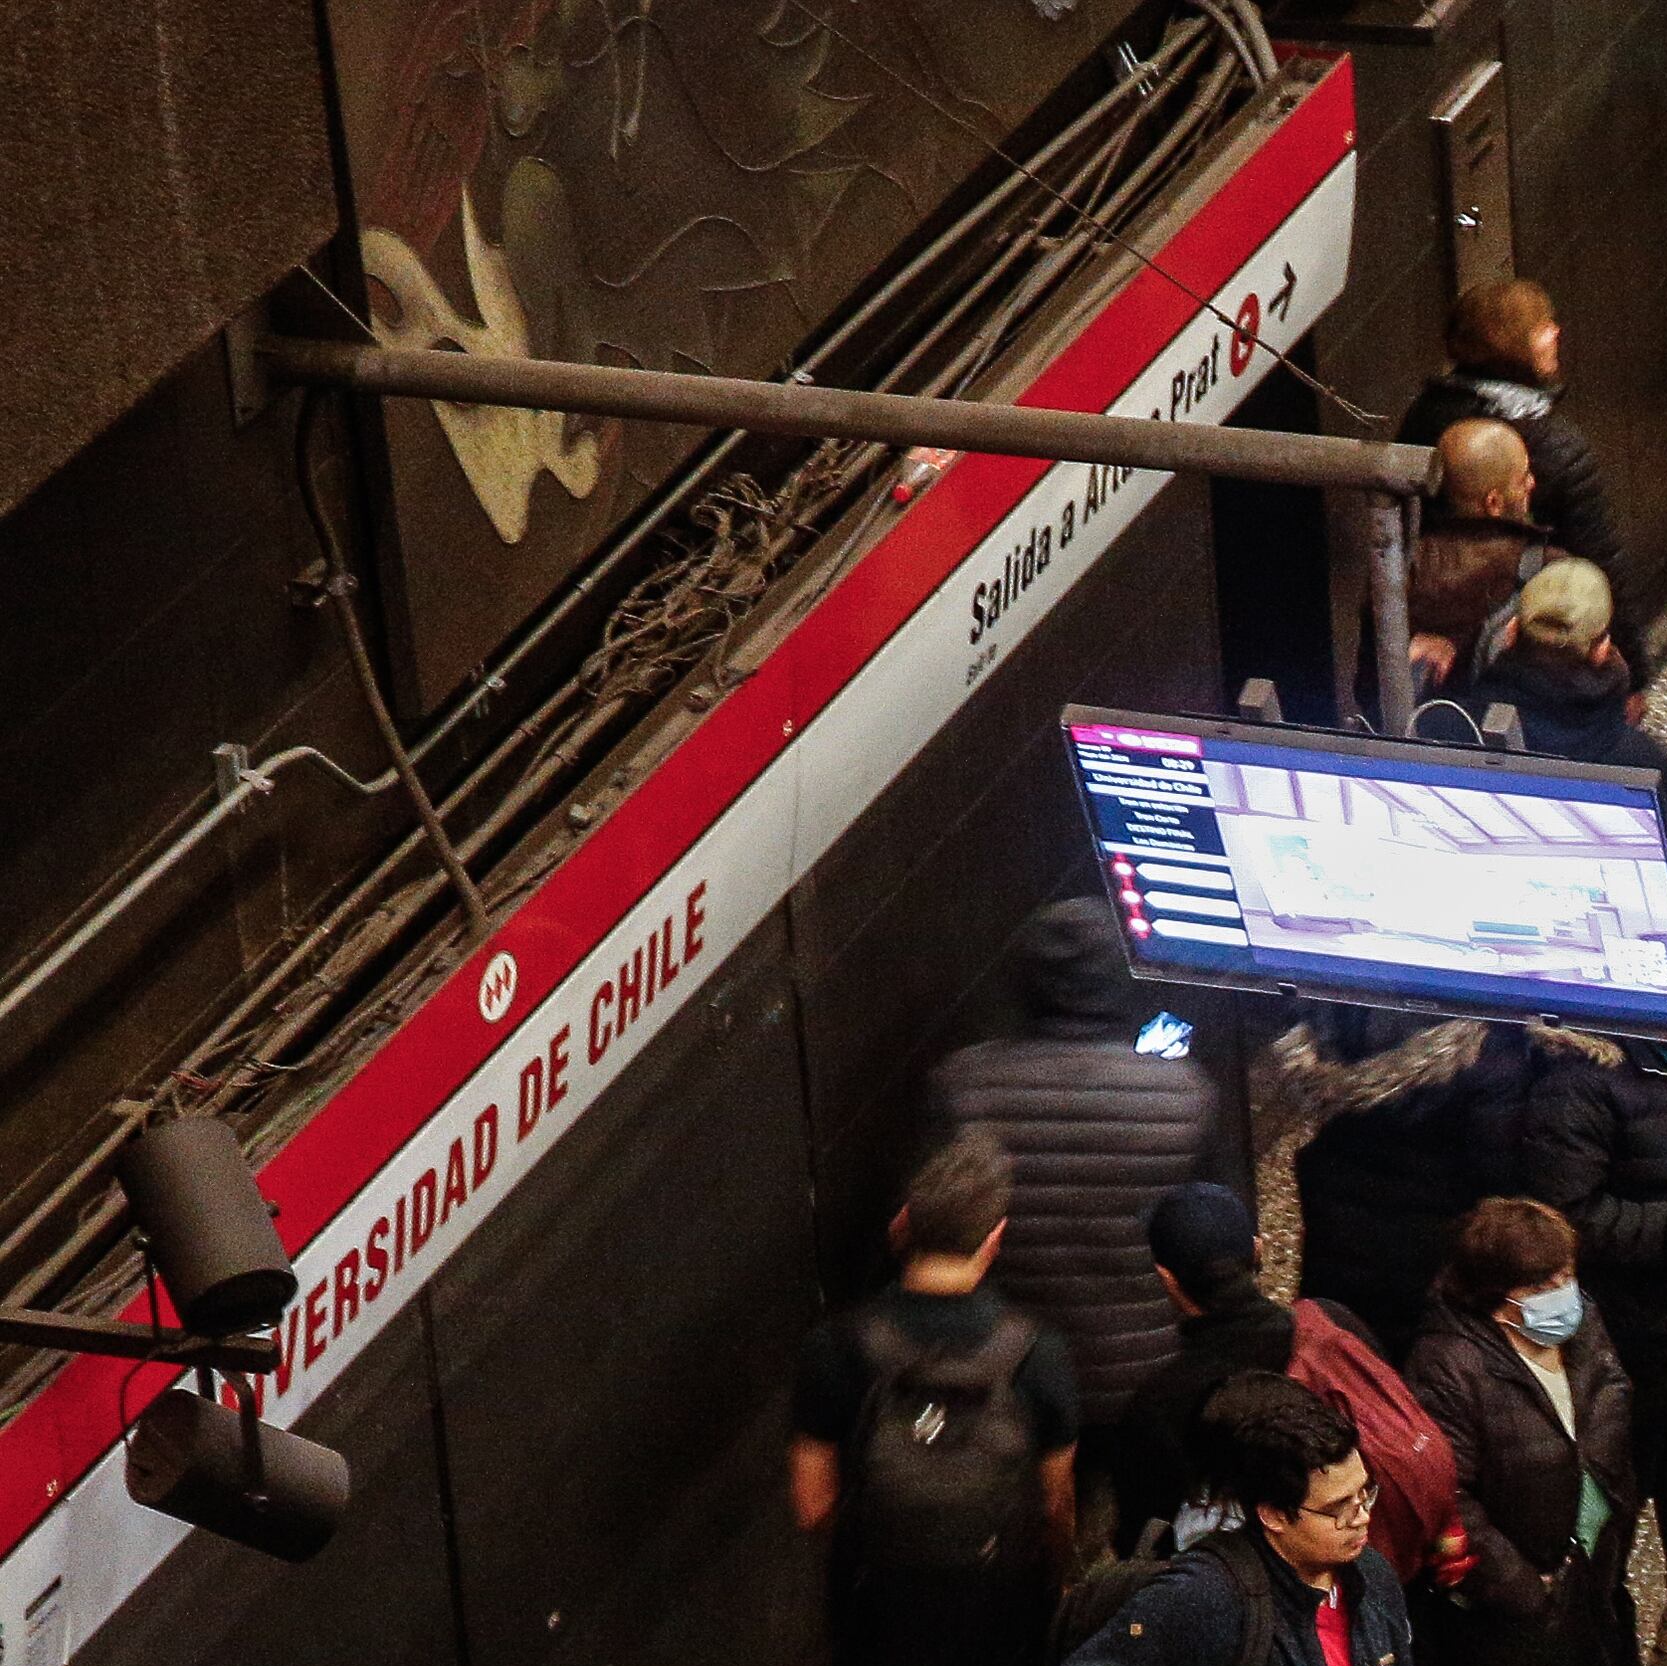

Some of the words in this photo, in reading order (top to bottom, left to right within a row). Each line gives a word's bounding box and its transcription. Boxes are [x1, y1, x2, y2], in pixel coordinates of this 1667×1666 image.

[969, 525, 1051, 645] Salida
[1060, 500, 1075, 549] a
[1170, 332, 1219, 422] Prat
[219, 1103, 498, 1418] IVERSIDAD
[517, 1023, 571, 1143] DE
[587, 879, 707, 1066] CHILE
